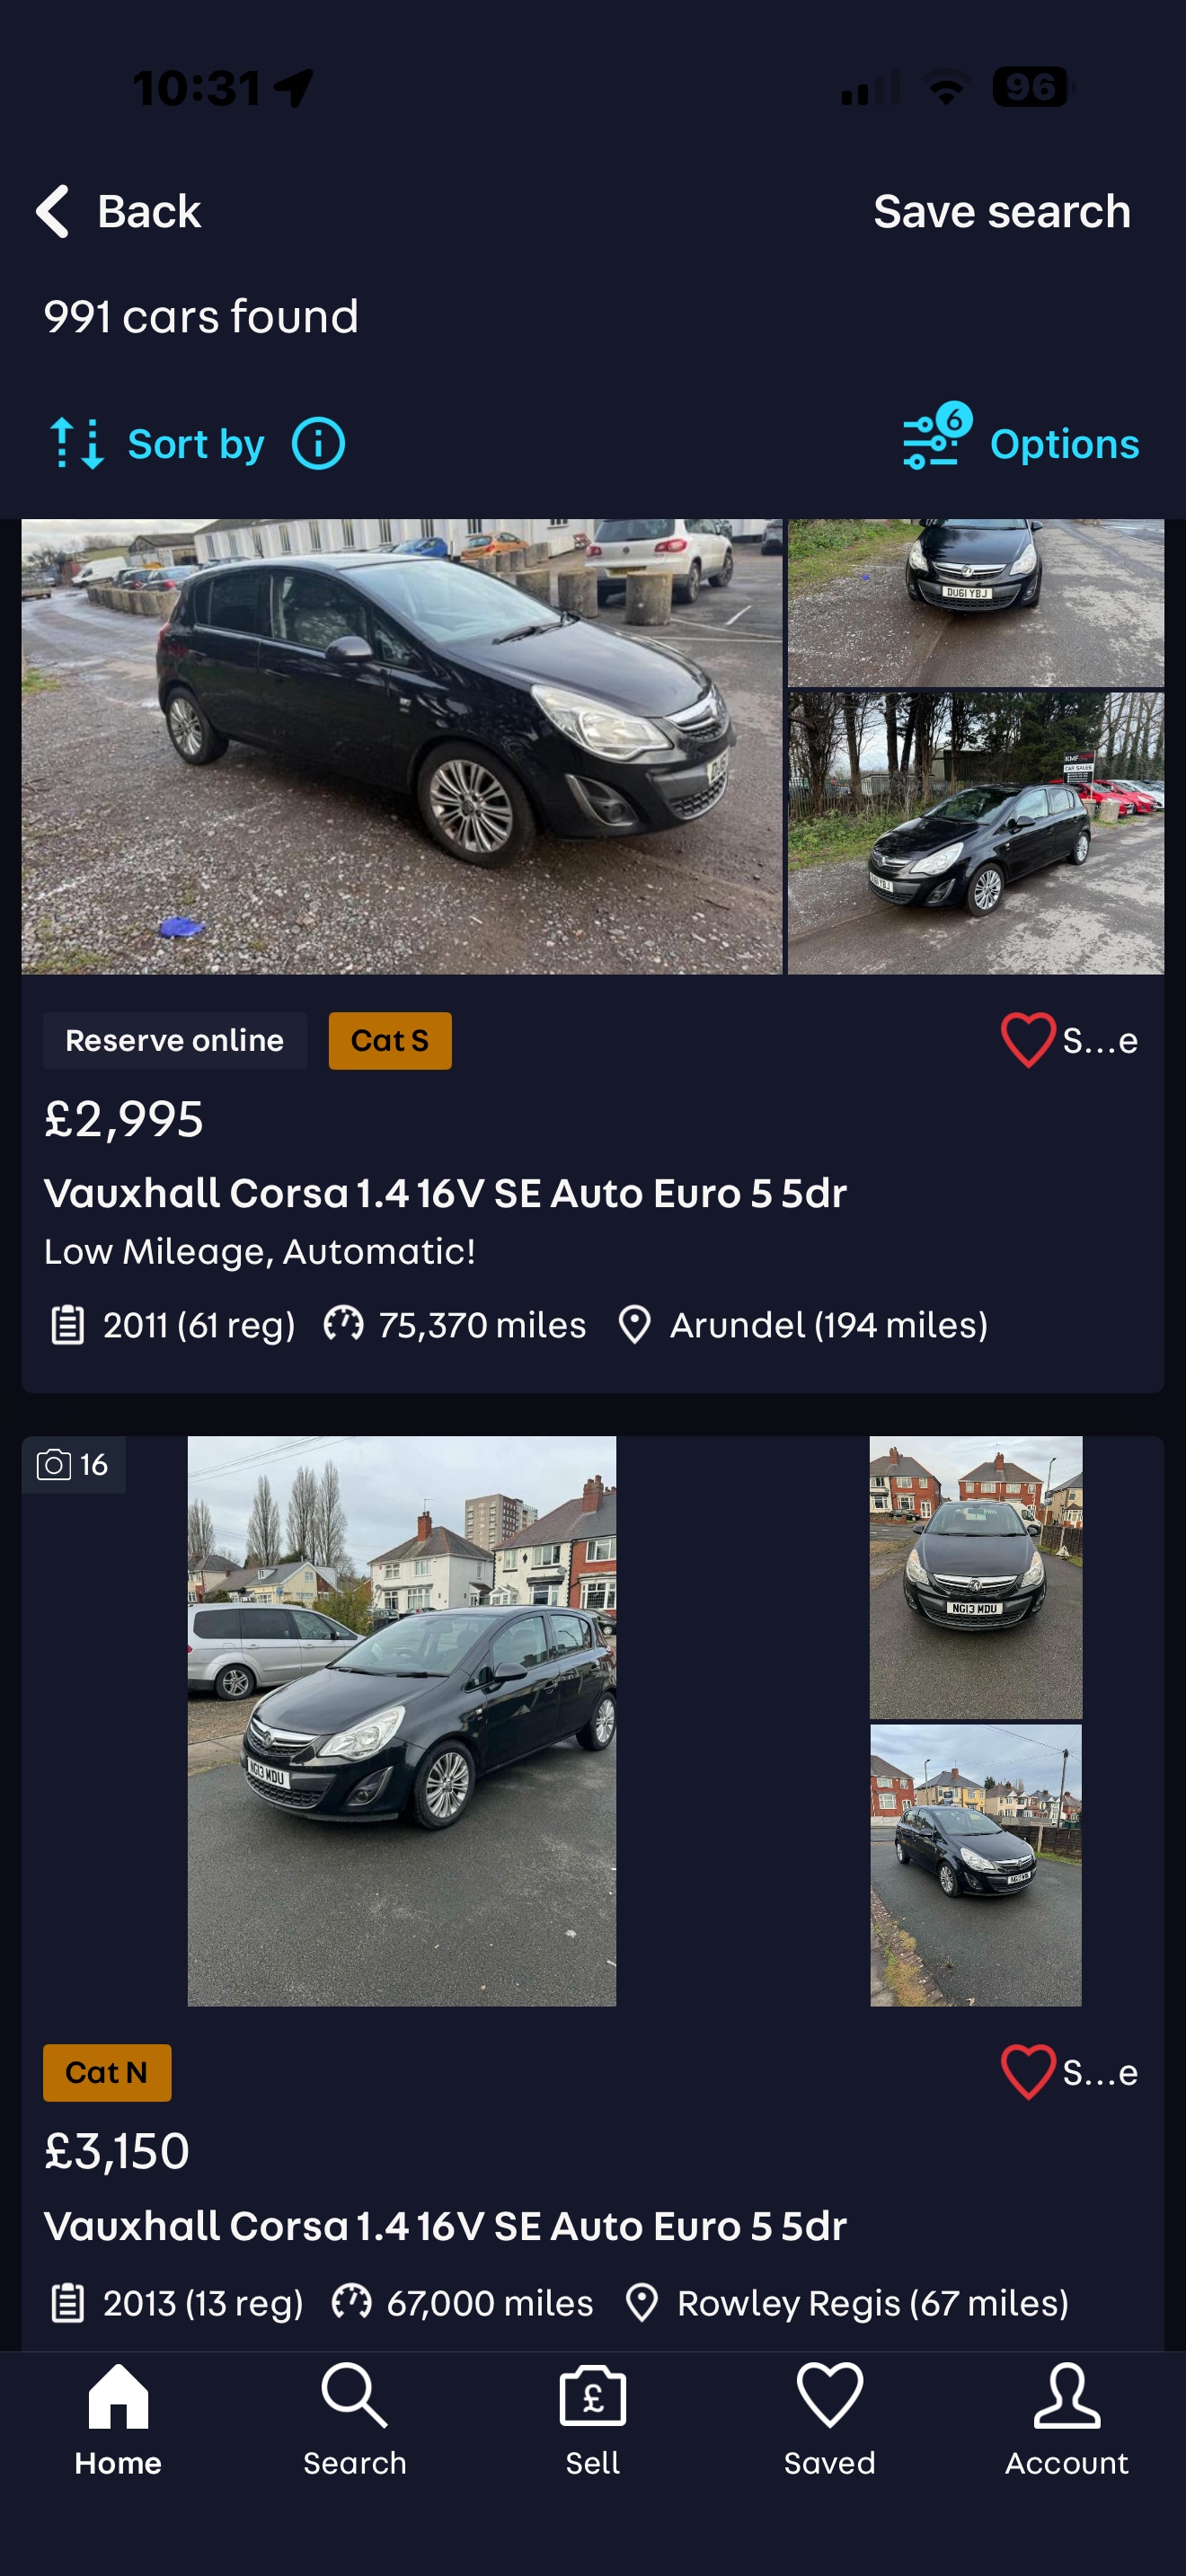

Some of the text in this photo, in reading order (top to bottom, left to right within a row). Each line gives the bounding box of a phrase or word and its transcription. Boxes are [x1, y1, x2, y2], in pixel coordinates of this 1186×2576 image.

[134, 70, 258, 106] 10:31
[1007, 73, 1056, 101] 96
[100, 193, 201, 228] Back
[875, 193, 1129, 228] Save search
[45, 297, 357, 333] 991 cars found
[947, 409, 962, 431] 6
[128, 428, 265, 466] Sort by
[991, 427, 1139, 465] Options
[947, 588, 987, 598] DU61 YBJ
[67, 1028, 283, 1052] Reserve online
[351, 1029, 429, 1052] Cat S
[46, 1100, 202, 1143] £2,995
[43, 1177, 847, 1208] Vauxhall Corsa 1.4 16V SE Auto Euro 5 5dr
[46, 1237, 474, 1272] Low Mileage, Automatic!
[104, 1311, 294, 1345] 2011 (61 reg)
[380, 1310, 586, 1343] 75,370 miles
[670, 1310, 987, 1342] Arundel (194 miles)
[81, 1453, 108, 1476] 16
[953, 1604, 997, 1614] NG13 MDU
[266, 1768, 284, 1786] MDU
[66, 2061, 146, 2084] Cat N
[46, 2132, 189, 2175] £3,150
[43, 2210, 847, 2241] Vauxhall Corsa 1.4 16V SE Auto Euro 5 5dr
[104, 2289, 302, 2324] 2013 (13 reg)
[388, 2289, 593, 2321] 67,000 miles
[679, 2289, 1067, 2324] Rowley Regis (67 miles)
[74, 2451, 162, 2475] Home
[304, 2450, 407, 2475] Search
[566, 2450, 621, 2475] Sell
[784, 2450, 876, 2475] Saved
[1005, 2451, 1129, 2475] Account
